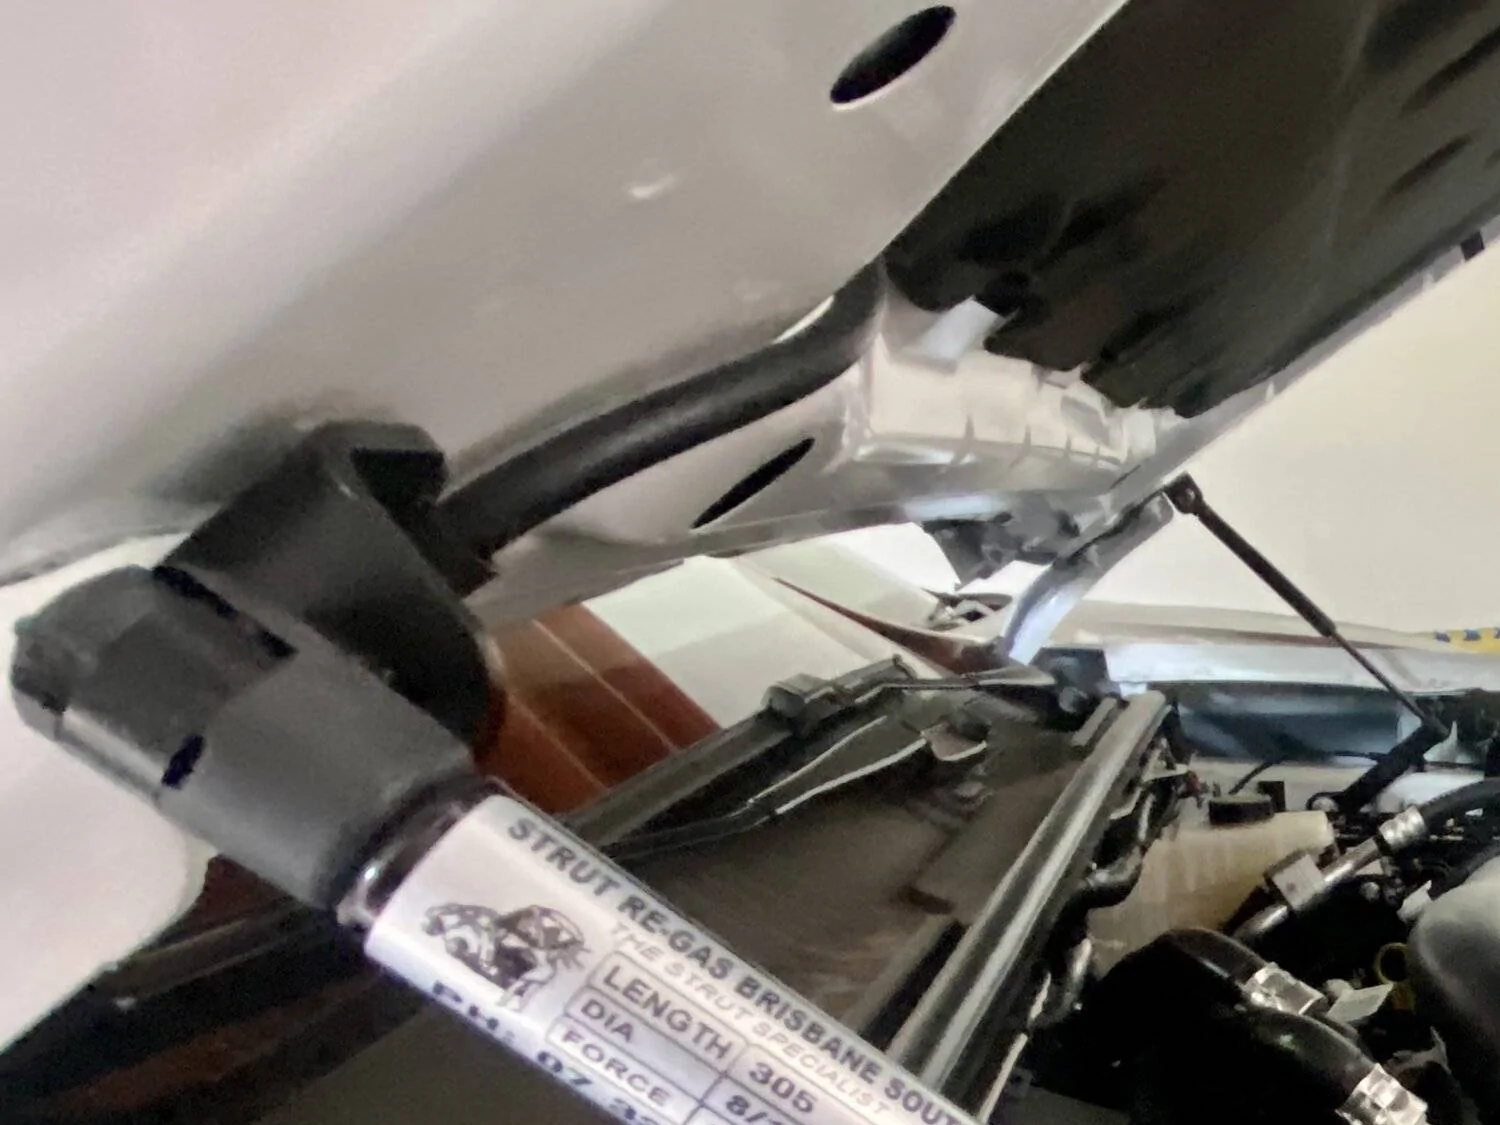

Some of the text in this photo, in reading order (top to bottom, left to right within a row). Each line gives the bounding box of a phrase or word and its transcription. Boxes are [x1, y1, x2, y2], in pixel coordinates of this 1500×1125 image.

[507, 818, 621, 898] STRUT
[617, 894, 734, 980] RE-GAS
[734, 974, 880, 1084] BRISBANE
[535, 1050, 591, 1090] 07
[562, 1025, 671, 1105] FORCE
[580, 999, 634, 1043] DIA
[602, 965, 816, 1114] LENGTH 305
[611, 920, 890, 1114] THE STRUT SPECIALIST
